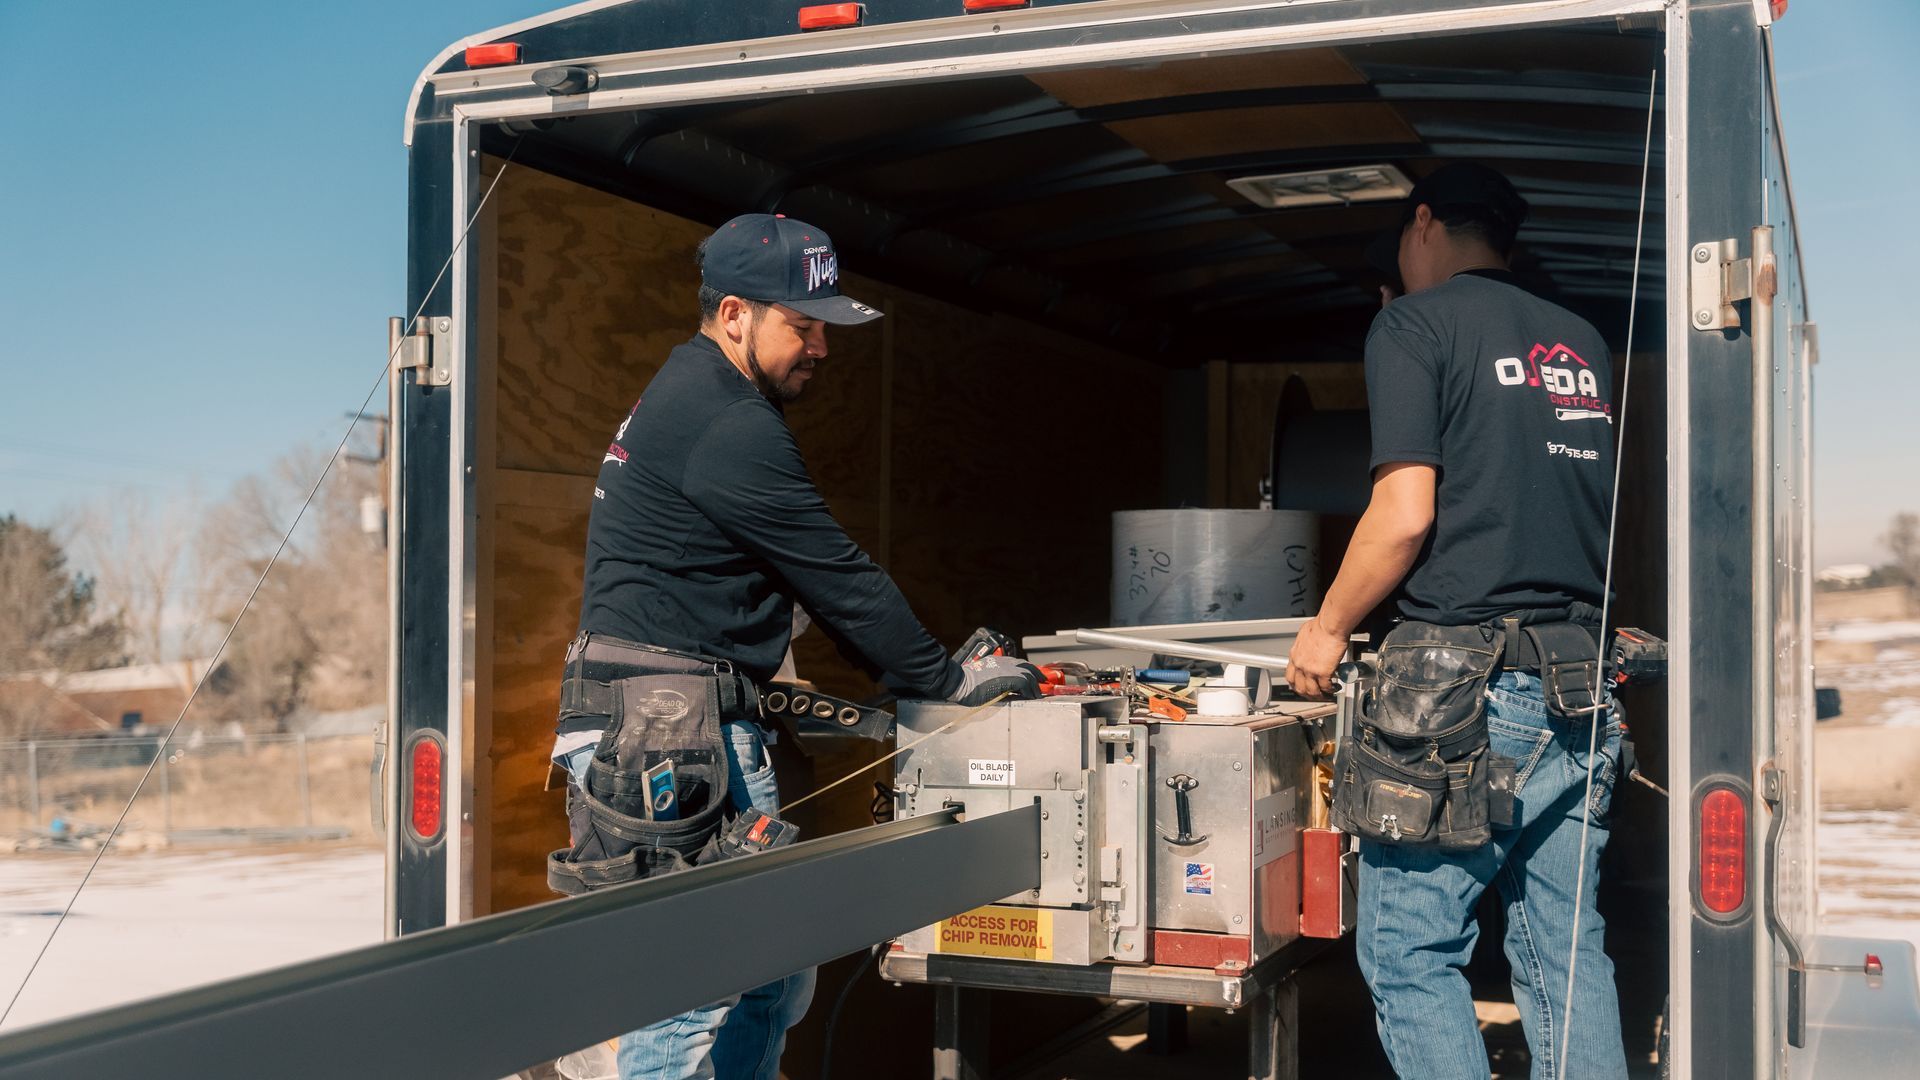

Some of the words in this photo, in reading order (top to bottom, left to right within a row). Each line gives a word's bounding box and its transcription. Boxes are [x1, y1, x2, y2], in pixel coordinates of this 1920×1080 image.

[804, 245, 828, 255] DENVER
[970, 762, 984, 771] OIL
[986, 763, 1014, 771] BLADE
[980, 773, 1004, 781] DAILY
[950, 915, 1006, 930] ACCESS
[1010, 918, 1038, 933] FOR
[942, 929, 975, 943] CHIP
[979, 932, 1047, 949] REMOVAL
